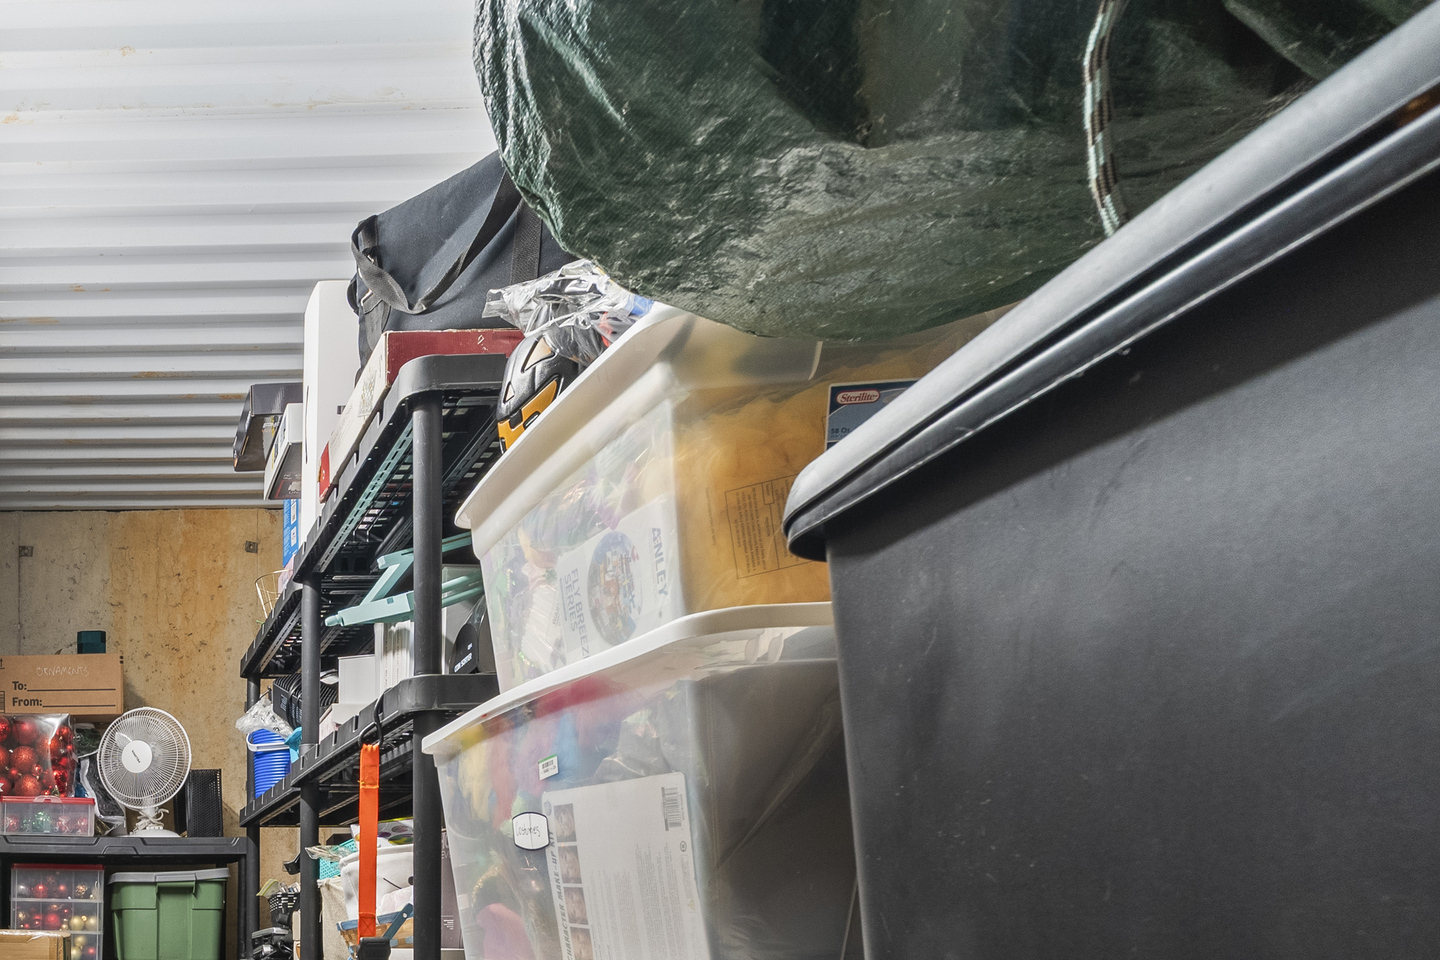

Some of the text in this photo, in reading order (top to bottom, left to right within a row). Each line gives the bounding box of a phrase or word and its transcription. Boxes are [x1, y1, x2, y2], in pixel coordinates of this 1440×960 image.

[840, 391, 874, 403] Sterilite
[651, 527, 669, 597] ANLEY
[564, 572, 578, 632] SERIES
[570, 567, 590, 659] FLY BREEZ
[12, 681, 27, 691] To:
[35, 665, 90, 677] ORNAMENTS
[12, 697, 43, 707] From:
[550, 850, 563, 901] MAKE-UP
